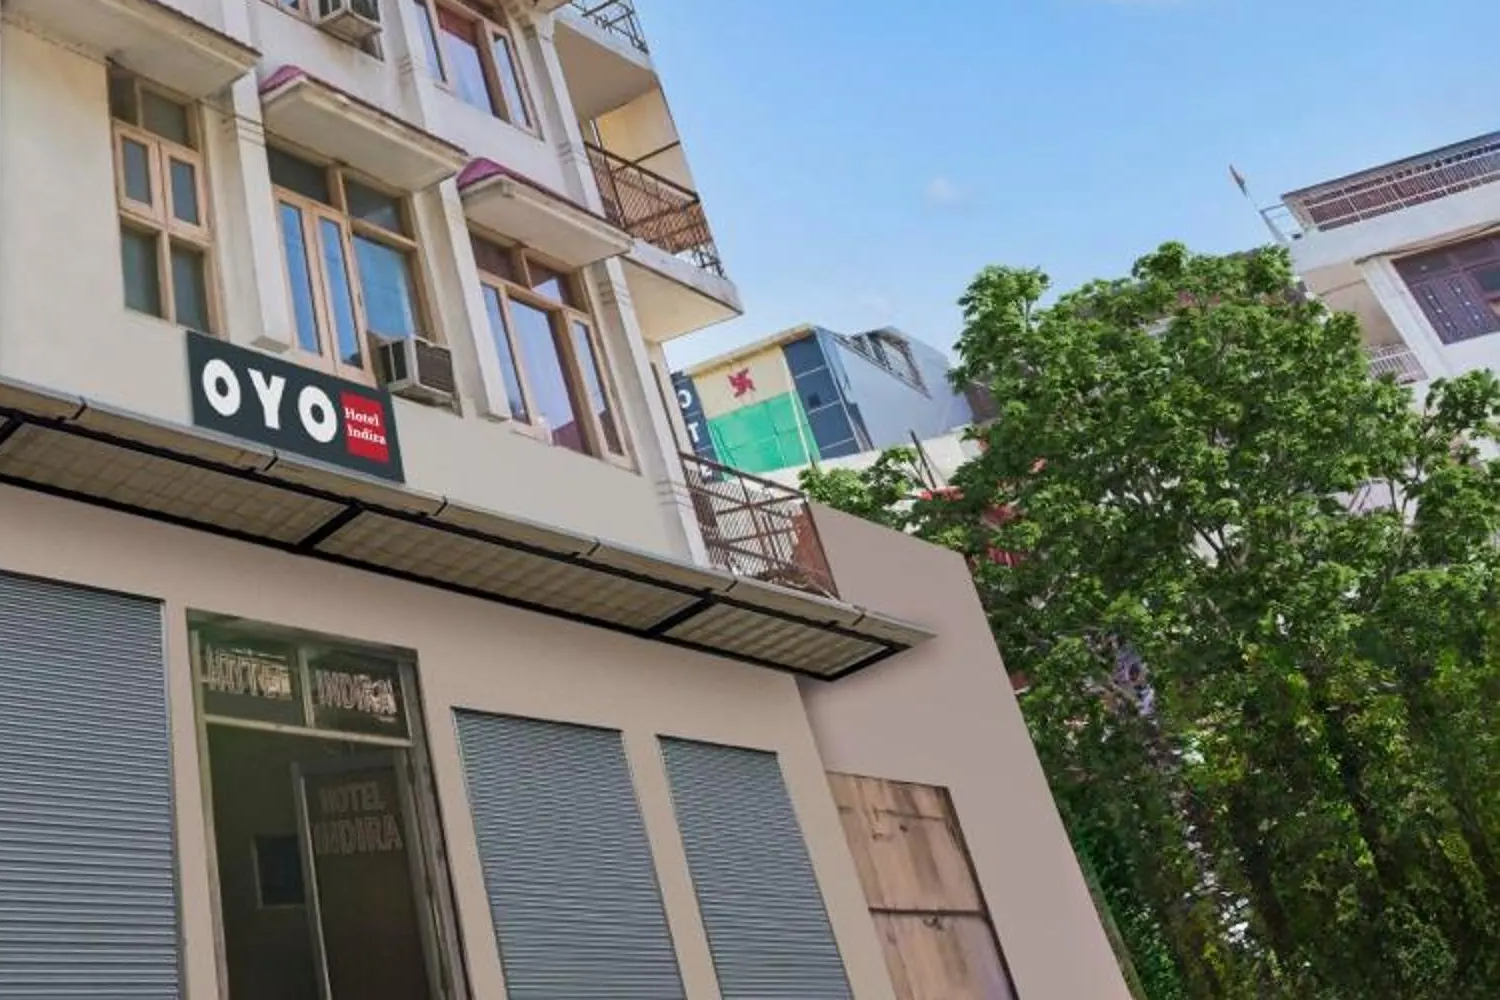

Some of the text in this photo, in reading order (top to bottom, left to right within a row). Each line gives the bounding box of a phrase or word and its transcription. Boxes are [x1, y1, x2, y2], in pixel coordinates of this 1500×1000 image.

[202, 358, 338, 443] OYO
[344, 406, 380, 427] Hotel
[346, 423, 386, 445] Indira
